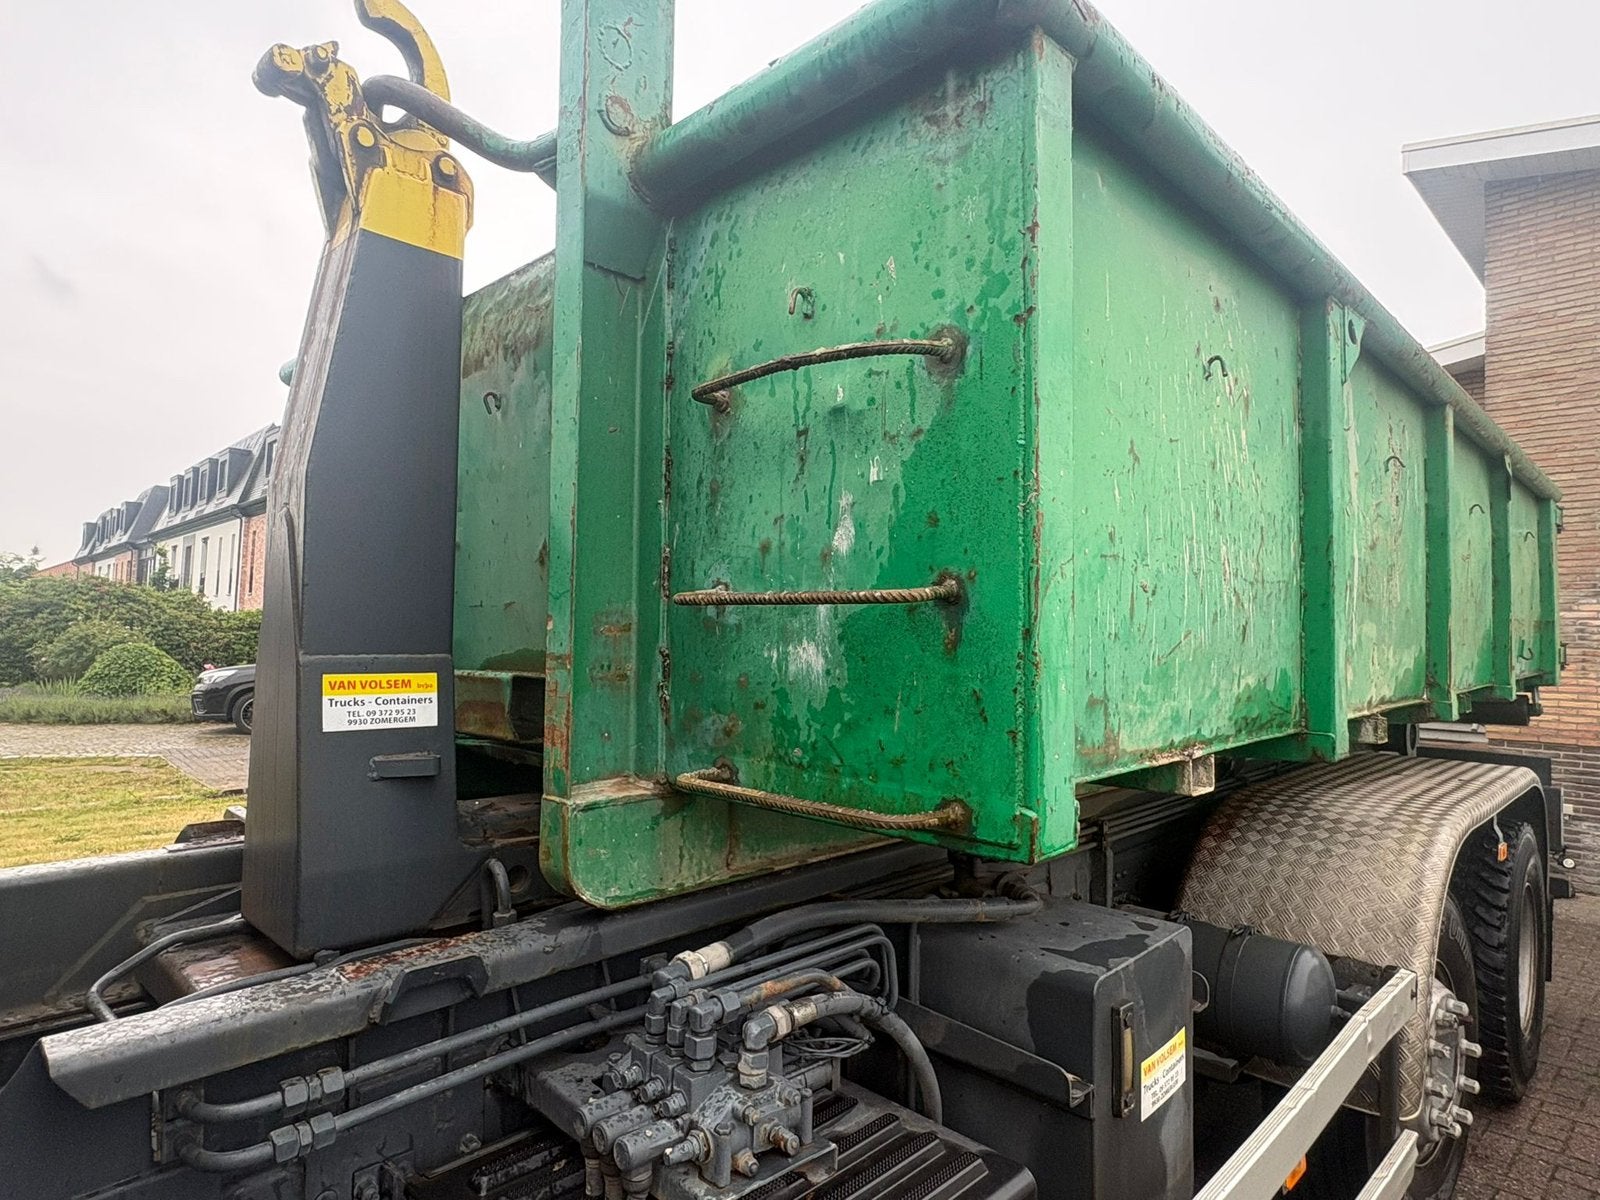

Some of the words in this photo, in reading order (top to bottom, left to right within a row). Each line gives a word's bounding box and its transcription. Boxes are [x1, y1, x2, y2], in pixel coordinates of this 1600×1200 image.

[328, 680, 356, 690] VAN
[360, 679, 411, 689] VOLSEM
[328, 697, 365, 707] Trucks
[375, 695, 433, 705] Containers
[369, 716, 416, 725] ZOMERGEM
[1143, 1061, 1156, 1077] VAN
[1156, 1042, 1177, 1065] VOLSEM
[1143, 1077, 1160, 1095] Trucks
